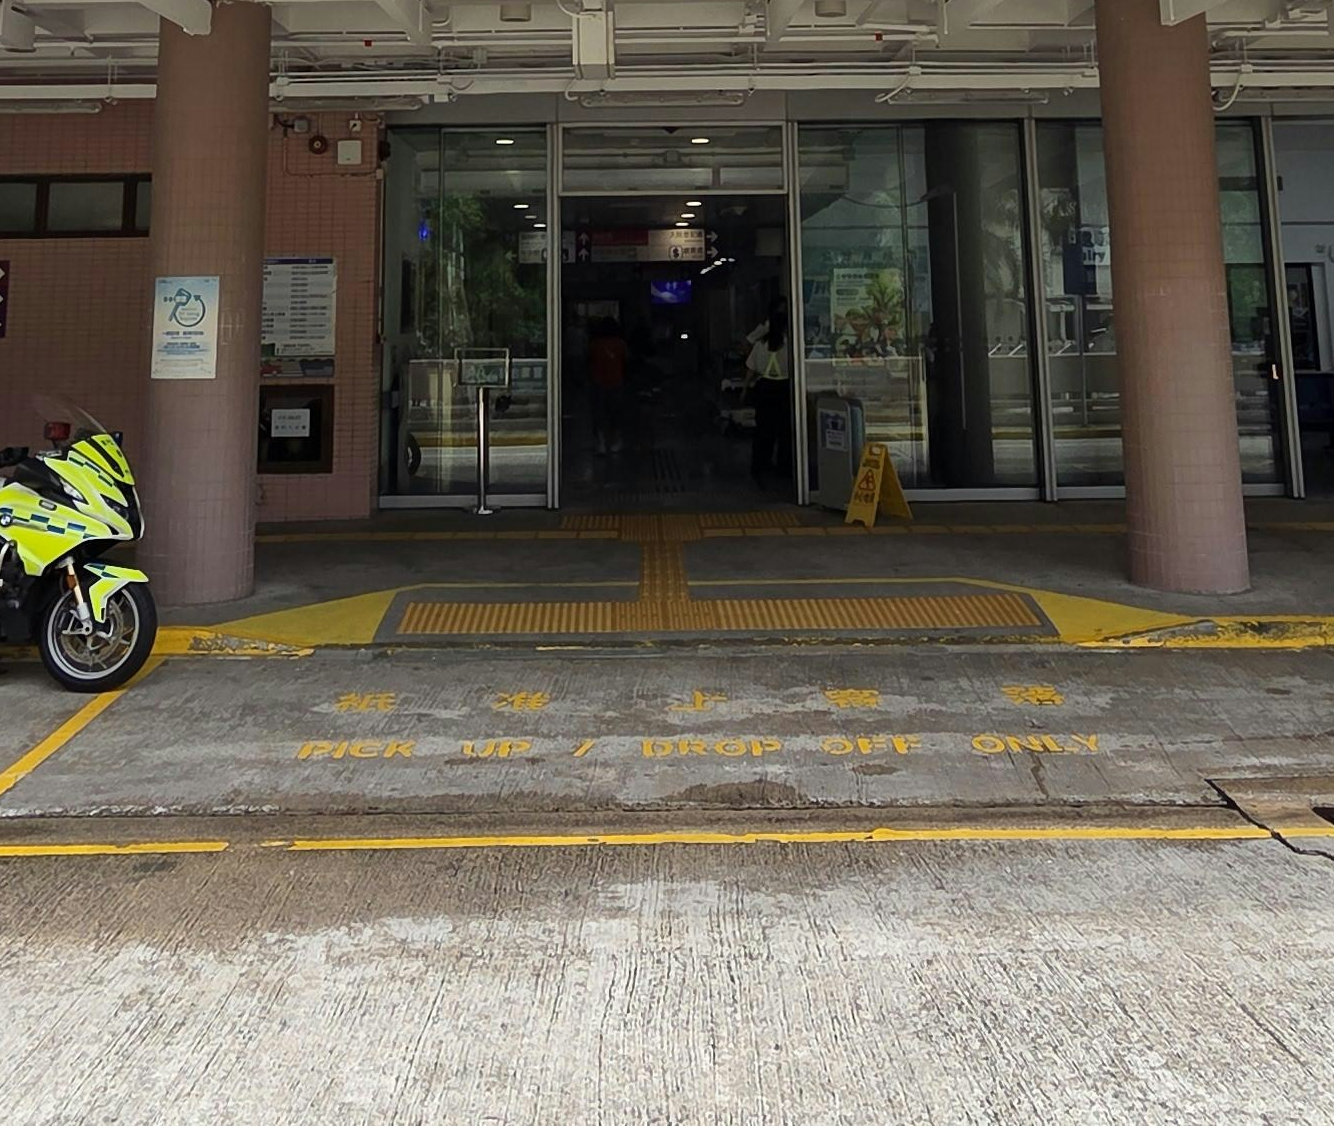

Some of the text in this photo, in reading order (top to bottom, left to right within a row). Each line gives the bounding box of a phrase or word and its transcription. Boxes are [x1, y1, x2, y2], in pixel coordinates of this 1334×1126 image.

[296, 738, 416, 759] PICK
[462, 737, 533, 758] UP
[641, 736, 782, 758] DROP
[819, 734, 921, 756] OFF
[969, 732, 1102, 755] ONLY
